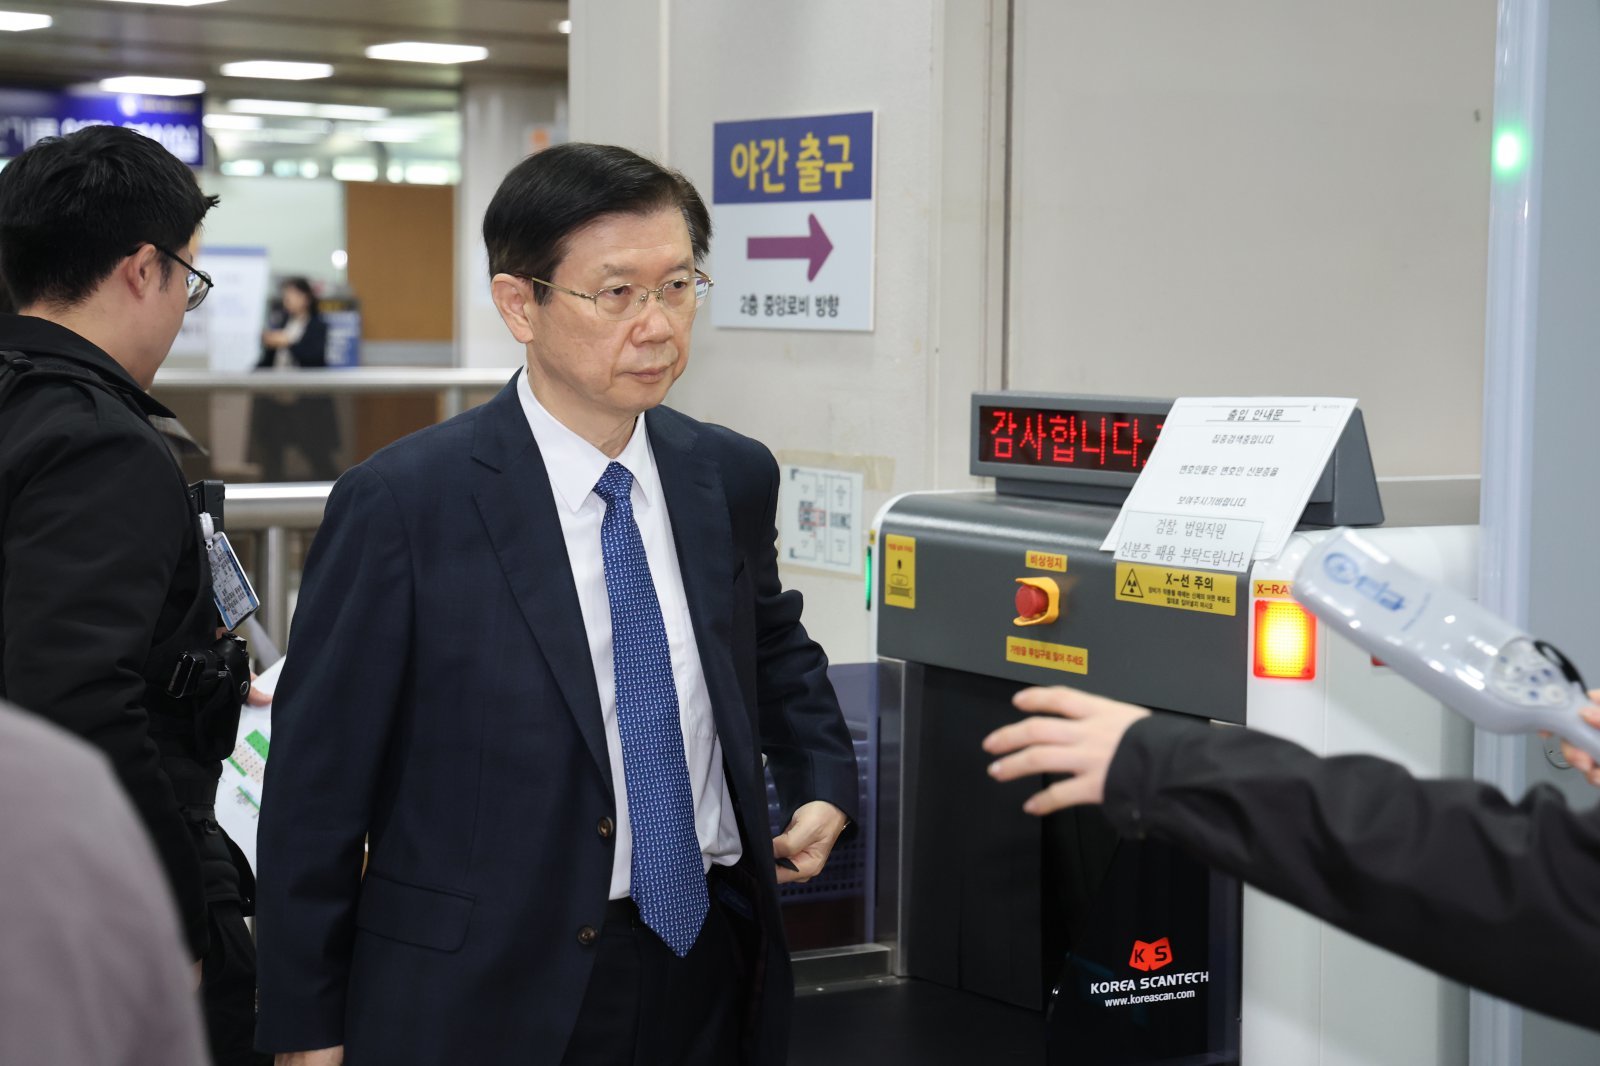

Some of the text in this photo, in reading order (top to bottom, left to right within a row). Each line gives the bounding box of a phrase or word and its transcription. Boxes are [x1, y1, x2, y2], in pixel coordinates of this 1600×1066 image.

[730, 132, 854, 193] 야간 출구
[740, 294, 838, 317] 2층 중앙로비 방향
[1227, 409, 1284, 421] 출입 안내문
[1220, 465, 1245, 477] 변호인
[1246, 466, 1280, 478] 신분증을
[1185, 521, 1227, 540] 법원직원
[1030, 554, 1062, 569] 비상정지
[1120, 541, 1245, 568] 신분증 패용 부탁드립니다.
[1165, 573, 1214, 591] X-선 주의
[1256, 583, 1294, 595] X-RA
[1090, 971, 1209, 994] KOREA SCANTECH
[1104, 989, 1196, 1007] www.koreascan.com
